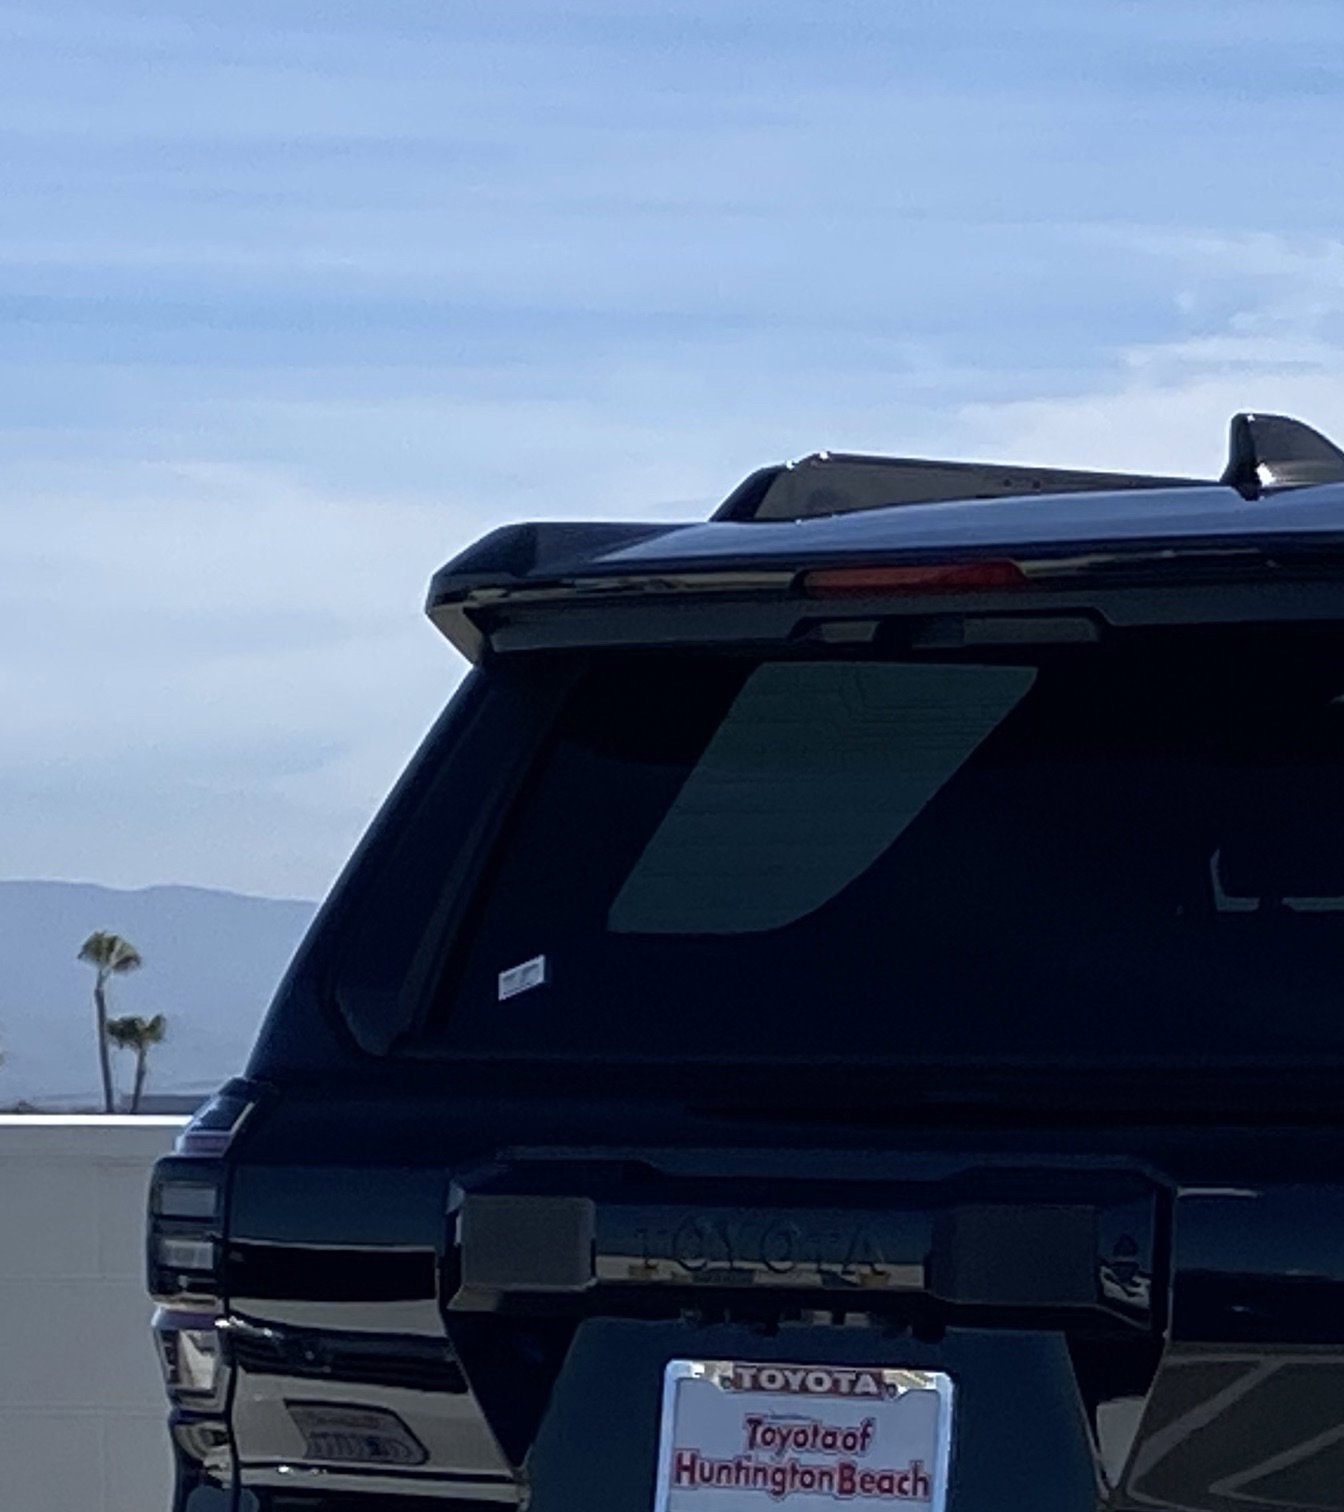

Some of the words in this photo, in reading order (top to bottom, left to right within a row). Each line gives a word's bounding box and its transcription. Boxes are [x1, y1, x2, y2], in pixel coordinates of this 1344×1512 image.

[733, 1366, 880, 1395] TOYOTA
[745, 1416, 838, 1450] Toyota
[842, 1418, 874, 1451] of
[675, 1451, 834, 1495] Huntington
[837, 1461, 929, 1497] Beach
